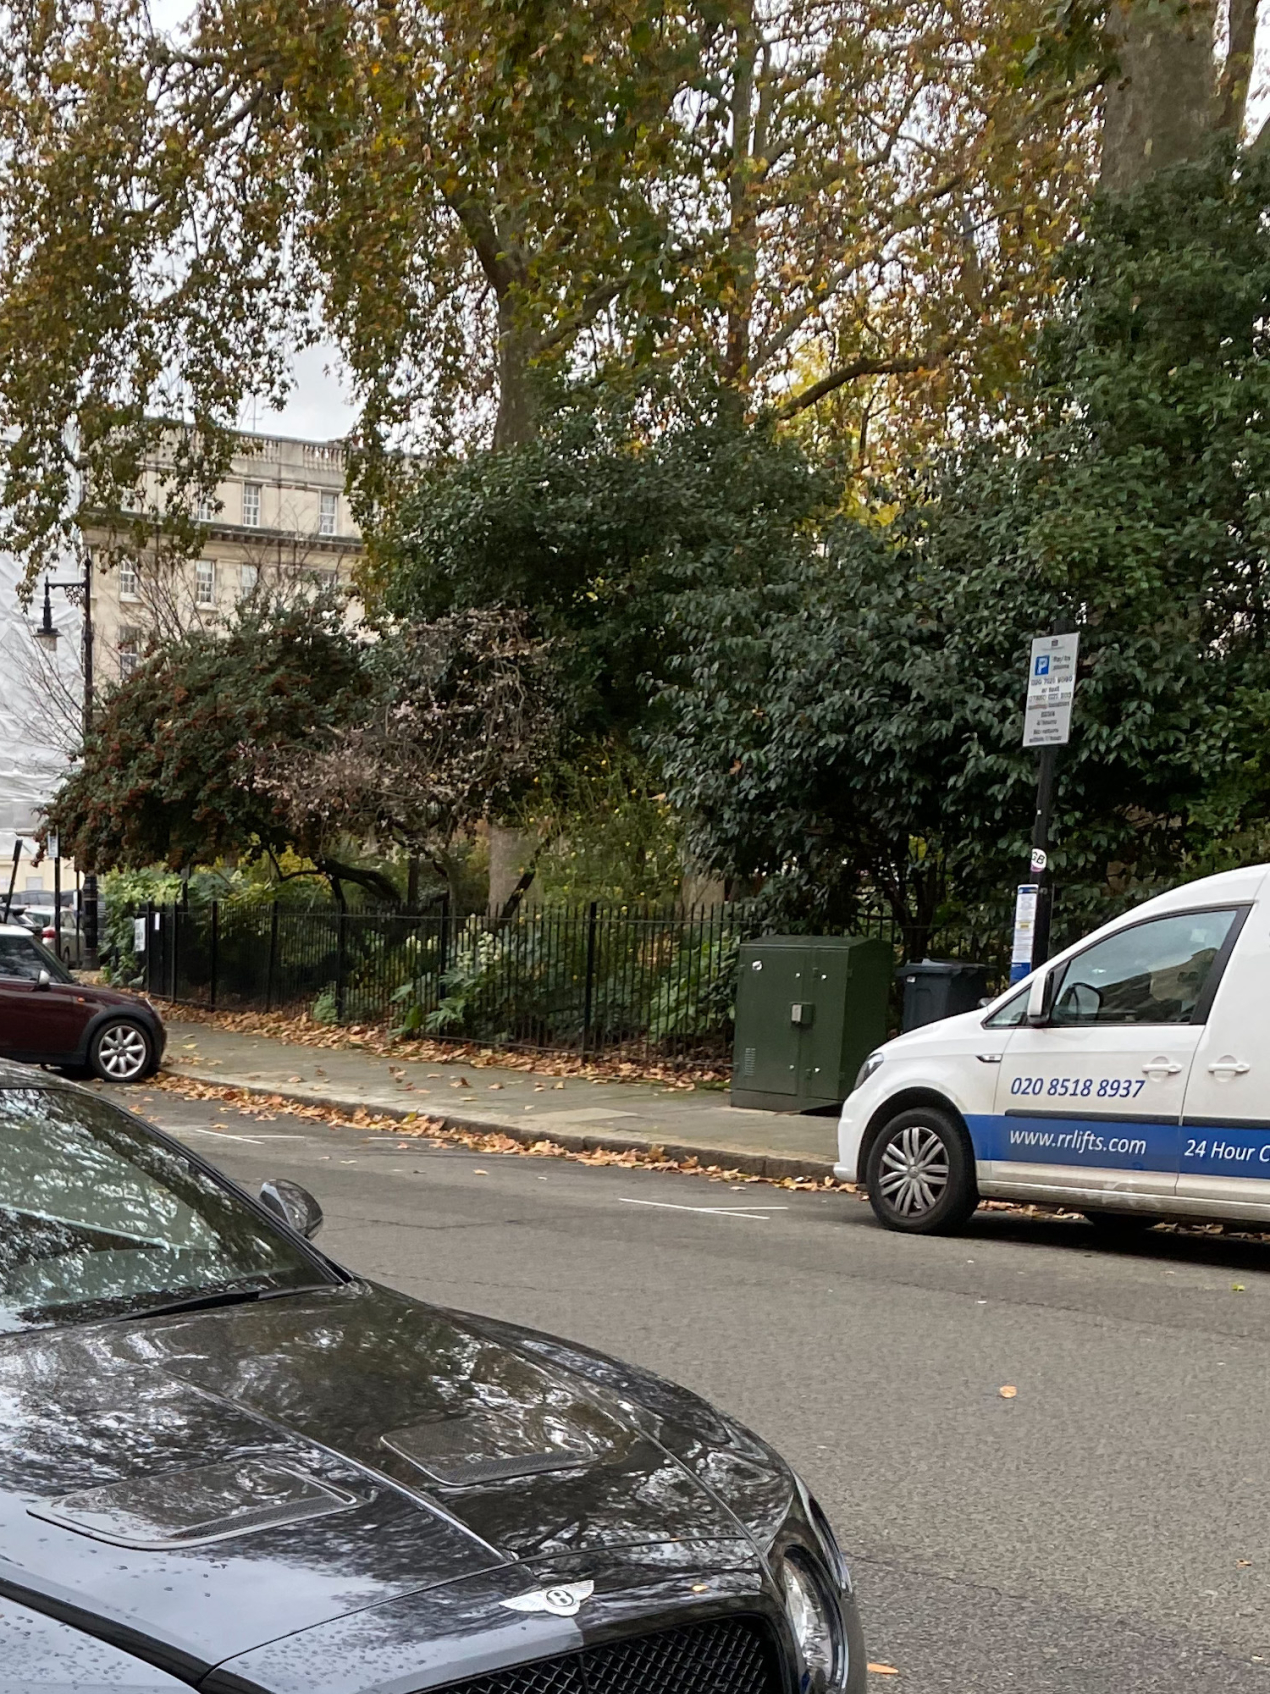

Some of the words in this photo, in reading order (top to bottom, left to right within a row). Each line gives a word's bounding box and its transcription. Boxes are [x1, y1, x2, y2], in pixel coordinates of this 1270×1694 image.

[1010, 1078, 1044, 1096] 020
[1047, 1078, 1093, 1098] 8518
[1096, 1079, 1146, 1098] 8937
[1009, 1129, 1147, 1155] www.rrlifts.com
[1183, 1139, 1208, 1158] 24
[1210, 1141, 1256, 1161] Hour
[1259, 1144, 1270, 1163] C
